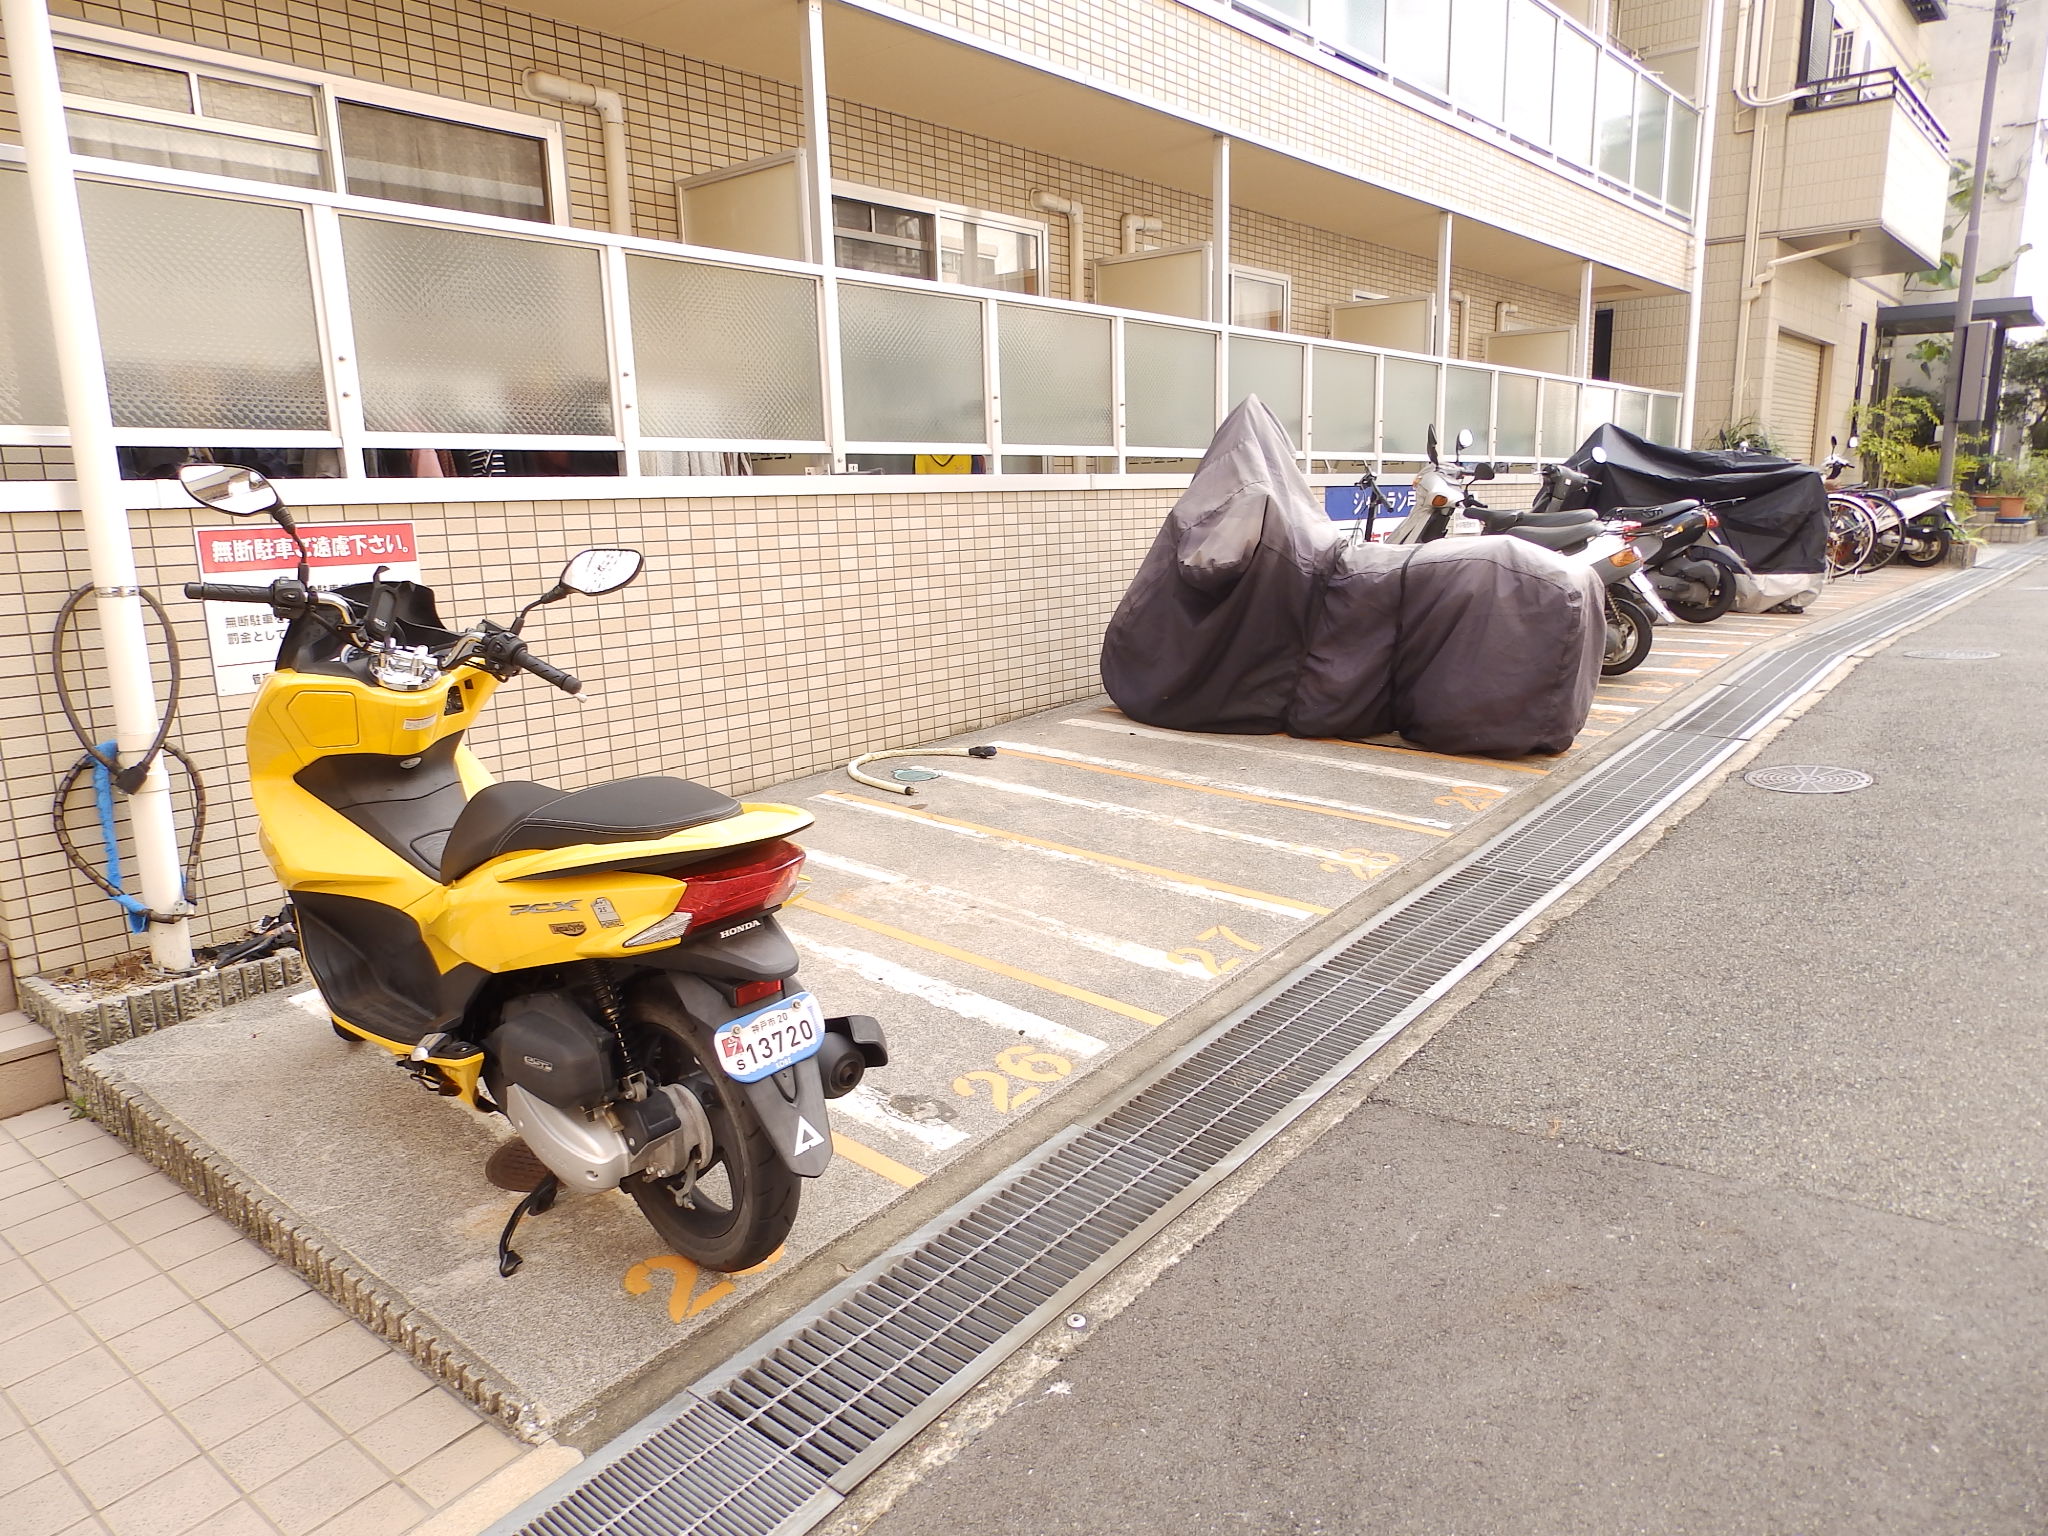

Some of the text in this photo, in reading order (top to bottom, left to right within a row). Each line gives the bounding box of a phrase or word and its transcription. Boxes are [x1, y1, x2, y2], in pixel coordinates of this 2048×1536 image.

[1433, 786, 1506, 812] 29
[509, 899, 582, 915] PCX
[720, 919, 761, 939] HONDA
[1166, 925, 1262, 975] 27
[777, 1012, 789, 1024] 20
[736, 1020, 813, 1070] S 13720
[952, 1045, 1073, 1113] 26
[624, 1244, 785, 1324] 2
